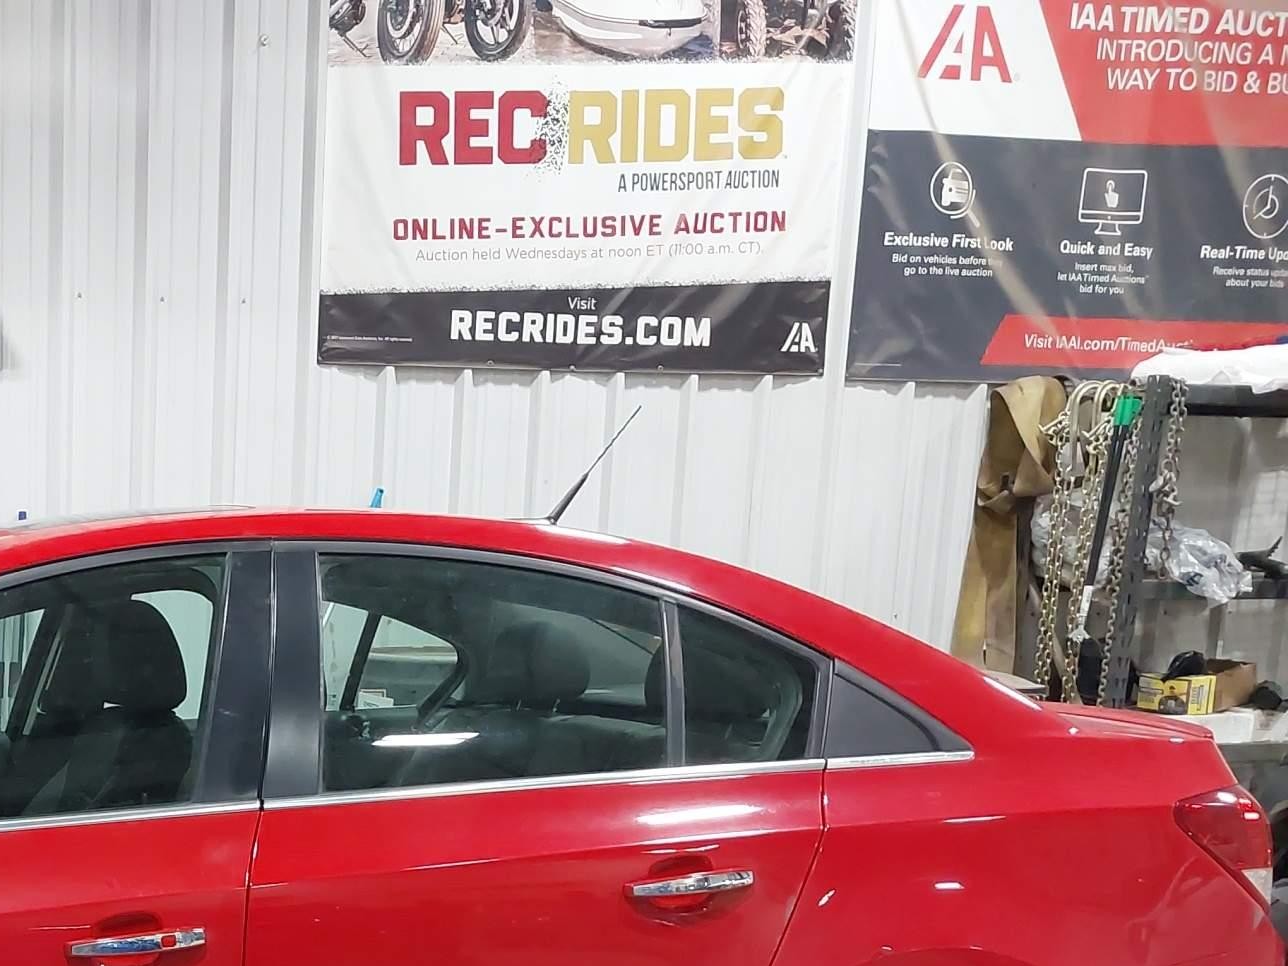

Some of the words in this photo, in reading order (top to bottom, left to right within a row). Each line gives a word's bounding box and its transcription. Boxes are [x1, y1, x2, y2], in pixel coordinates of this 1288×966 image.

[1070, 3, 1114, 32] IAA
[1121, 6, 1210, 35] TIMED
[1097, 38, 1253, 65] INTRODUCING
[1258, 44, 1274, 65] A
[1107, 68, 1160, 91] WAY
[1165, 68, 1197, 91] TO
[1204, 71, 1238, 93] BID
[1243, 72, 1261, 94] &
[399, 90, 548, 166] REC
[568, 87, 785, 165] RIDES
[617, 174, 628, 193] A
[631, 171, 723, 193] POWERSPORT
[725, 169, 781, 190] AUCTION
[393, 213, 663, 242] ONLINE-EXCLUSIVE
[673, 210, 788, 235] AUCTION
[883, 231, 949, 248] Exclusive
[952, 233, 982, 249] First
[415, 248, 469, 262] Auction
[472, 247, 501, 261] held
[505, 246, 587, 262] Wednesdays
[591, 249, 604, 259] at
[608, 248, 642, 258] noon
[646, 244, 664, 256] ET
[668, 243, 704, 257] (11:00
[707, 243, 734, 255] a.m.
[1060, 239, 1095, 256] Quick
[1097, 243, 1122, 257] and
[1124, 243, 1154, 260] Easy
[1200, 245, 1266, 260] Real-Time
[892, 253, 908, 264] Bid
[909, 256, 922, 264] on
[923, 254, 957, 266] vehicles
[959, 256, 987, 266] before
[1074, 262, 1098, 272] Insert
[903, 267, 916, 277] go
[918, 266, 928, 275] to
[929, 266, 944, 276] the
[945, 267, 960, 276] live
[961, 267, 993, 278] auction
[1057, 271, 1068, 281] let
[1068, 273, 1083, 281] IAA
[1082, 273, 1110, 283] Timed
[1079, 284, 1094, 294] bid
[1095, 284, 1108, 294] for
[1109, 285, 1125, 296] you
[1225, 279, 1250, 287] about
[568, 297, 597, 310] Visit
[450, 310, 711, 347] RECRIDES.COM
[1025, 334, 1053, 349] Visit
